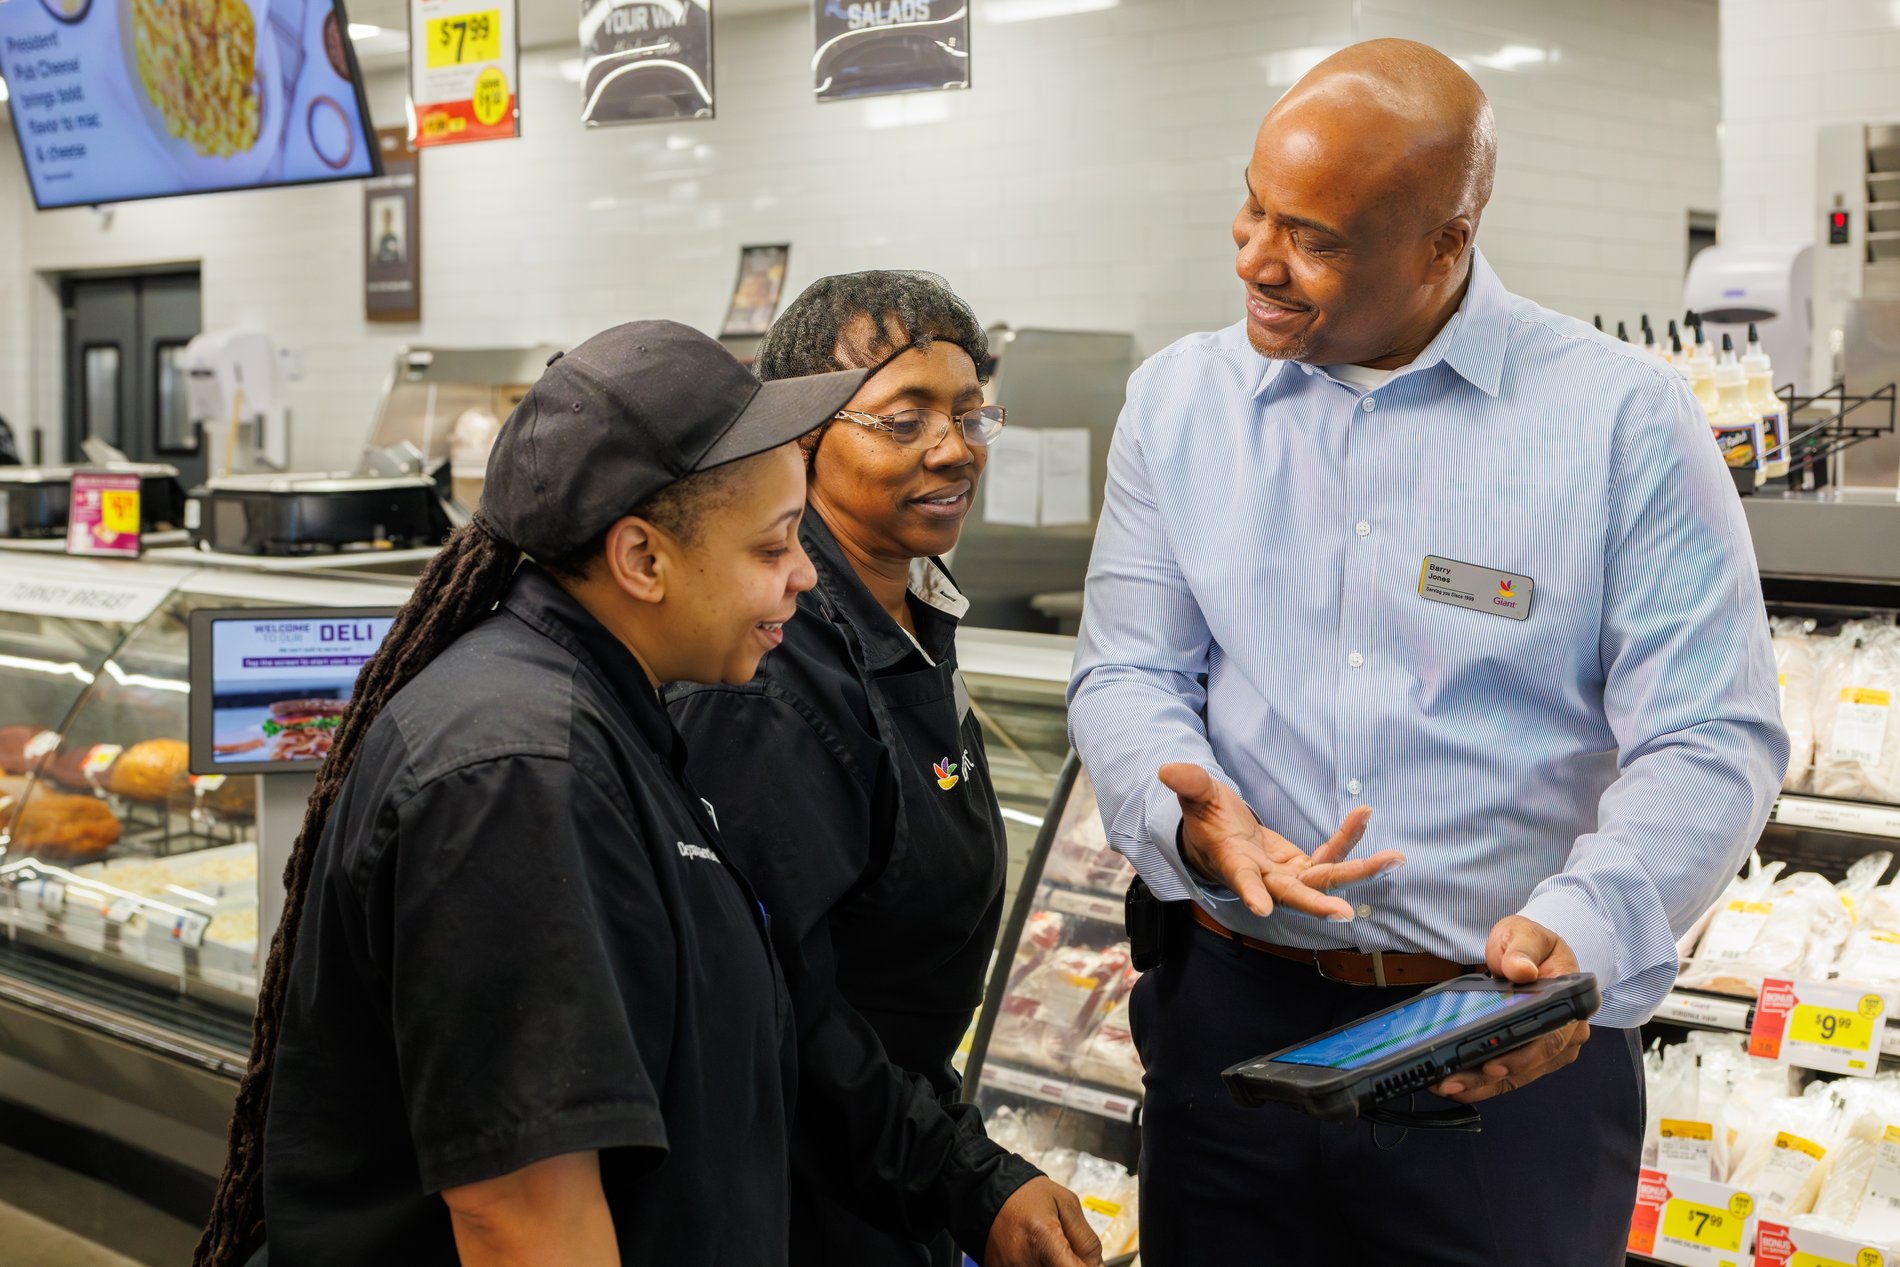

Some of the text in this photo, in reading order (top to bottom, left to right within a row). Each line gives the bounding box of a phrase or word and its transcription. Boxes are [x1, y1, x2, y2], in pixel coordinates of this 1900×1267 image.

[847, 0, 930, 29] SALADS
[1429, 563, 1451, 574] Barry
[1428, 573, 1451, 583] Jones
[1425, 586, 1442, 596] Serving
[1493, 596, 1516, 609] Giant
[254, 623, 373, 642] WELCOME DELI
[1762, 1236, 1791, 1250] BONUS
